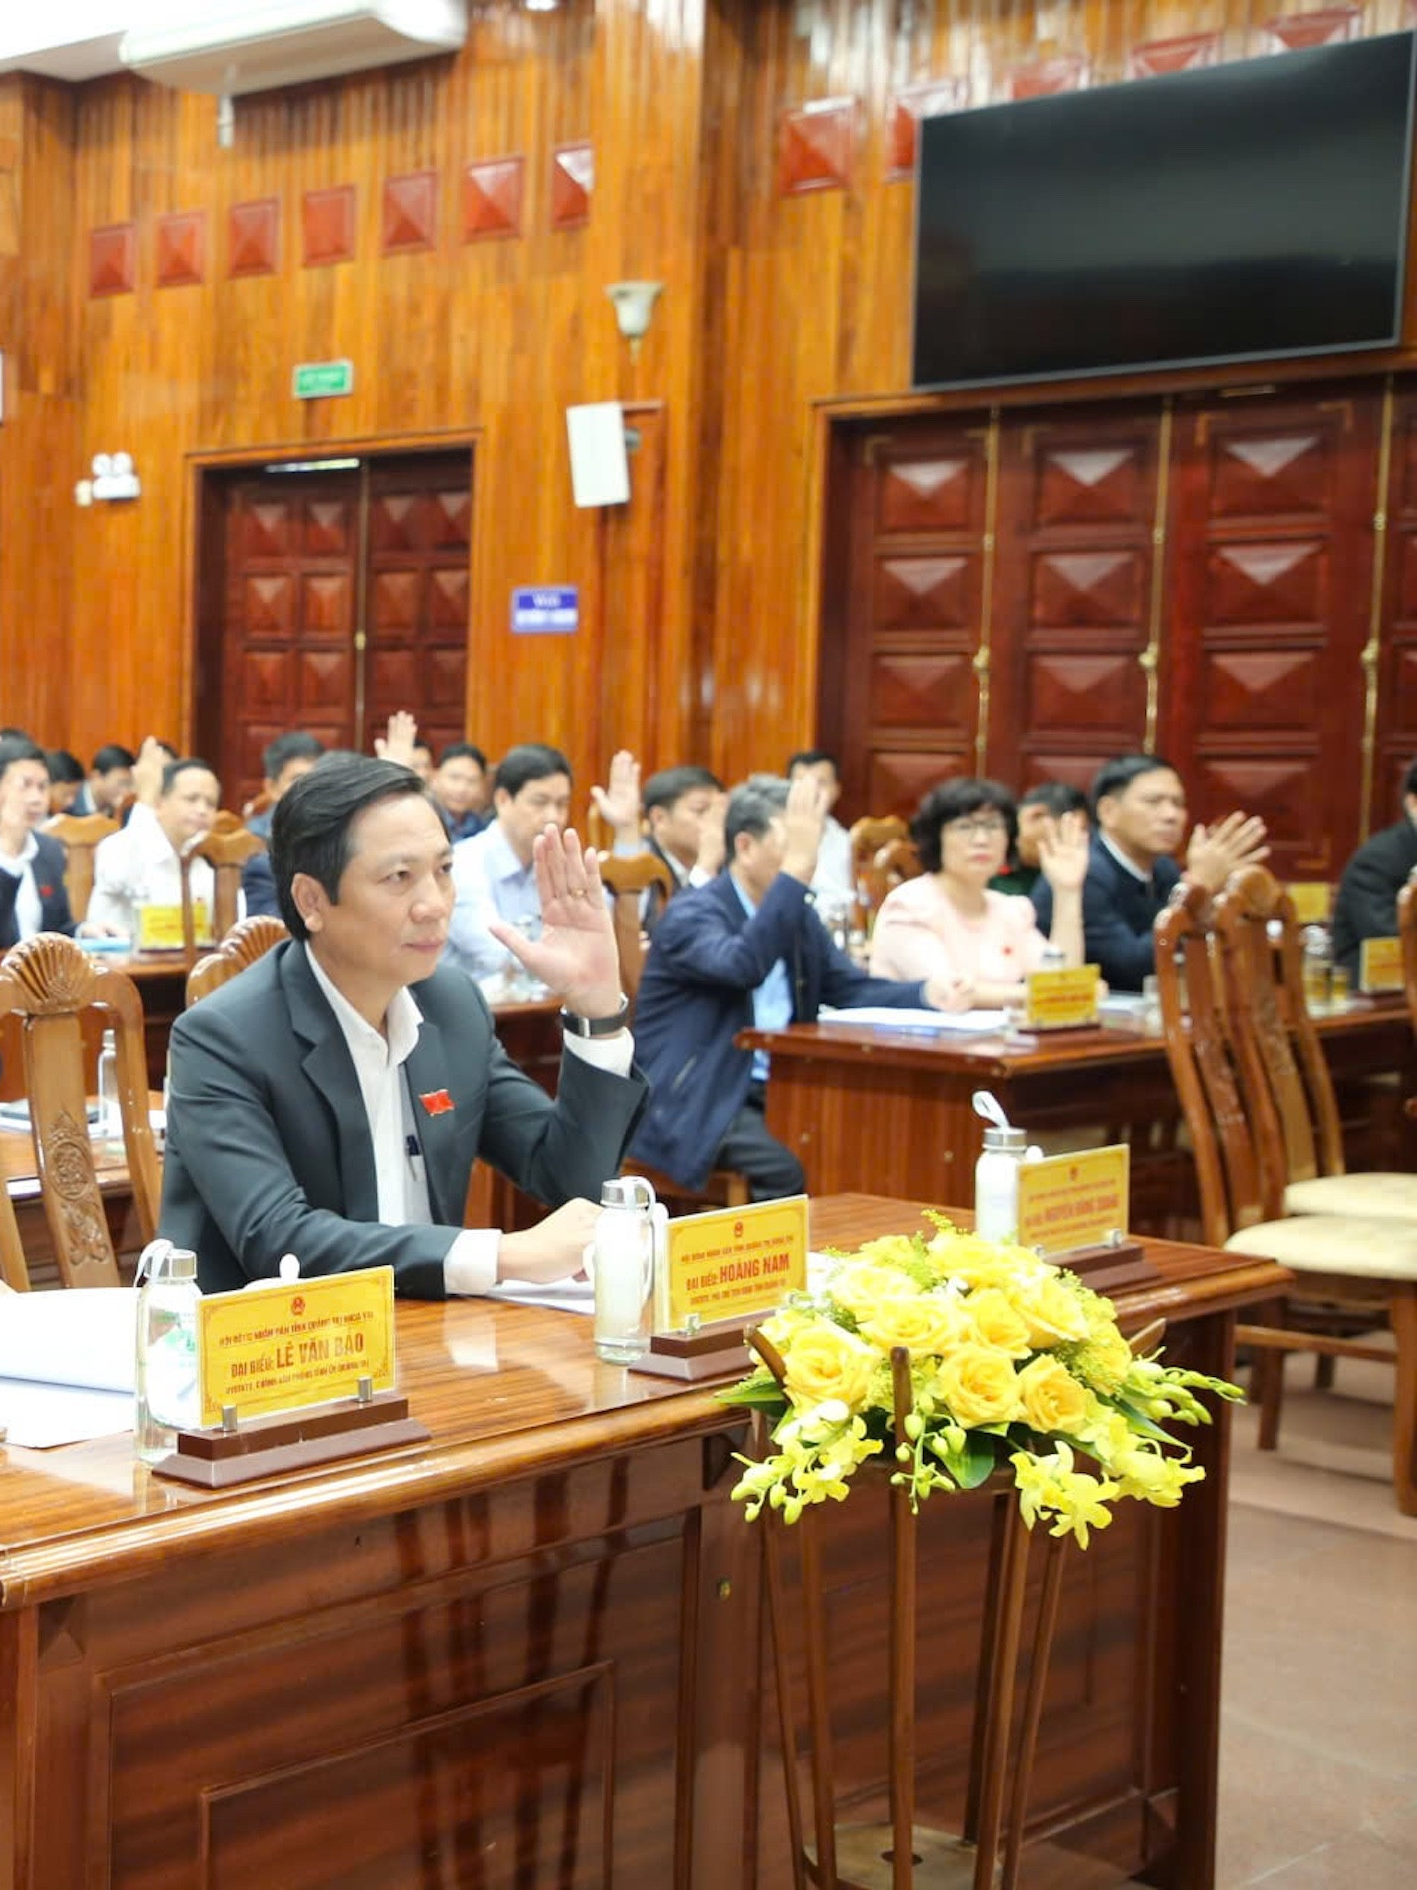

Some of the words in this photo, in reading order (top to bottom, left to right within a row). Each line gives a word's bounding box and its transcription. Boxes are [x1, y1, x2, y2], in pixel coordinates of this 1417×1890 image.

[719, 1257, 760, 1284] HOÀNG
[763, 1253, 790, 1275] NAM
[277, 1341, 294, 1369] LÊ
[299, 1337, 330, 1364] VĂN
